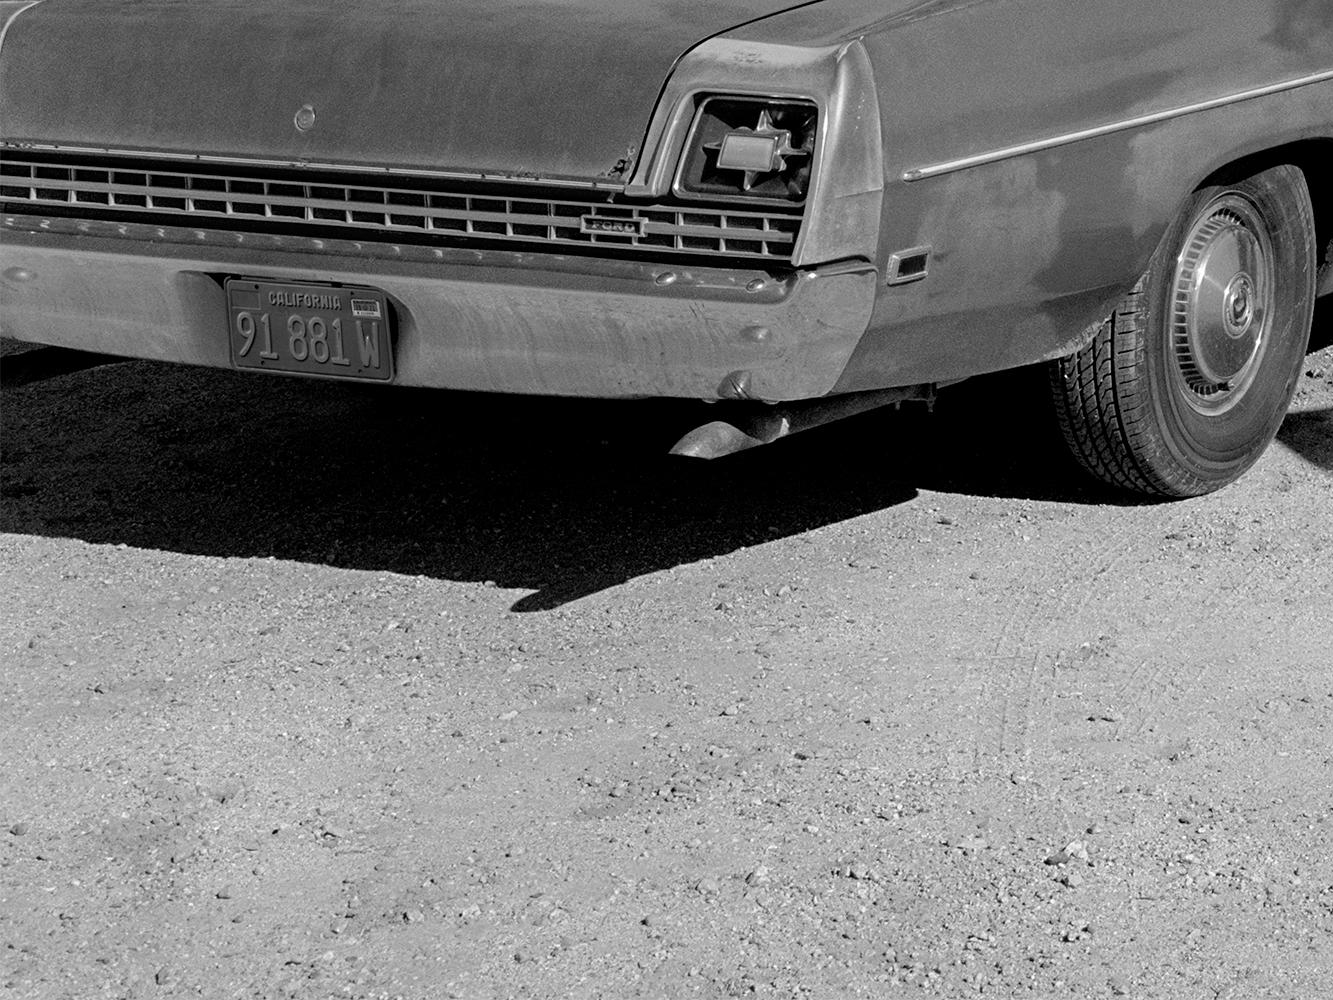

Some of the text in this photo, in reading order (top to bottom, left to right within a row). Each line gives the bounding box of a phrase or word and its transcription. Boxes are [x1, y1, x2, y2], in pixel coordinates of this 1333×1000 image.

[268, 291, 343, 311] CALIFORNIA
[236, 311, 380, 369] 91 881 W
